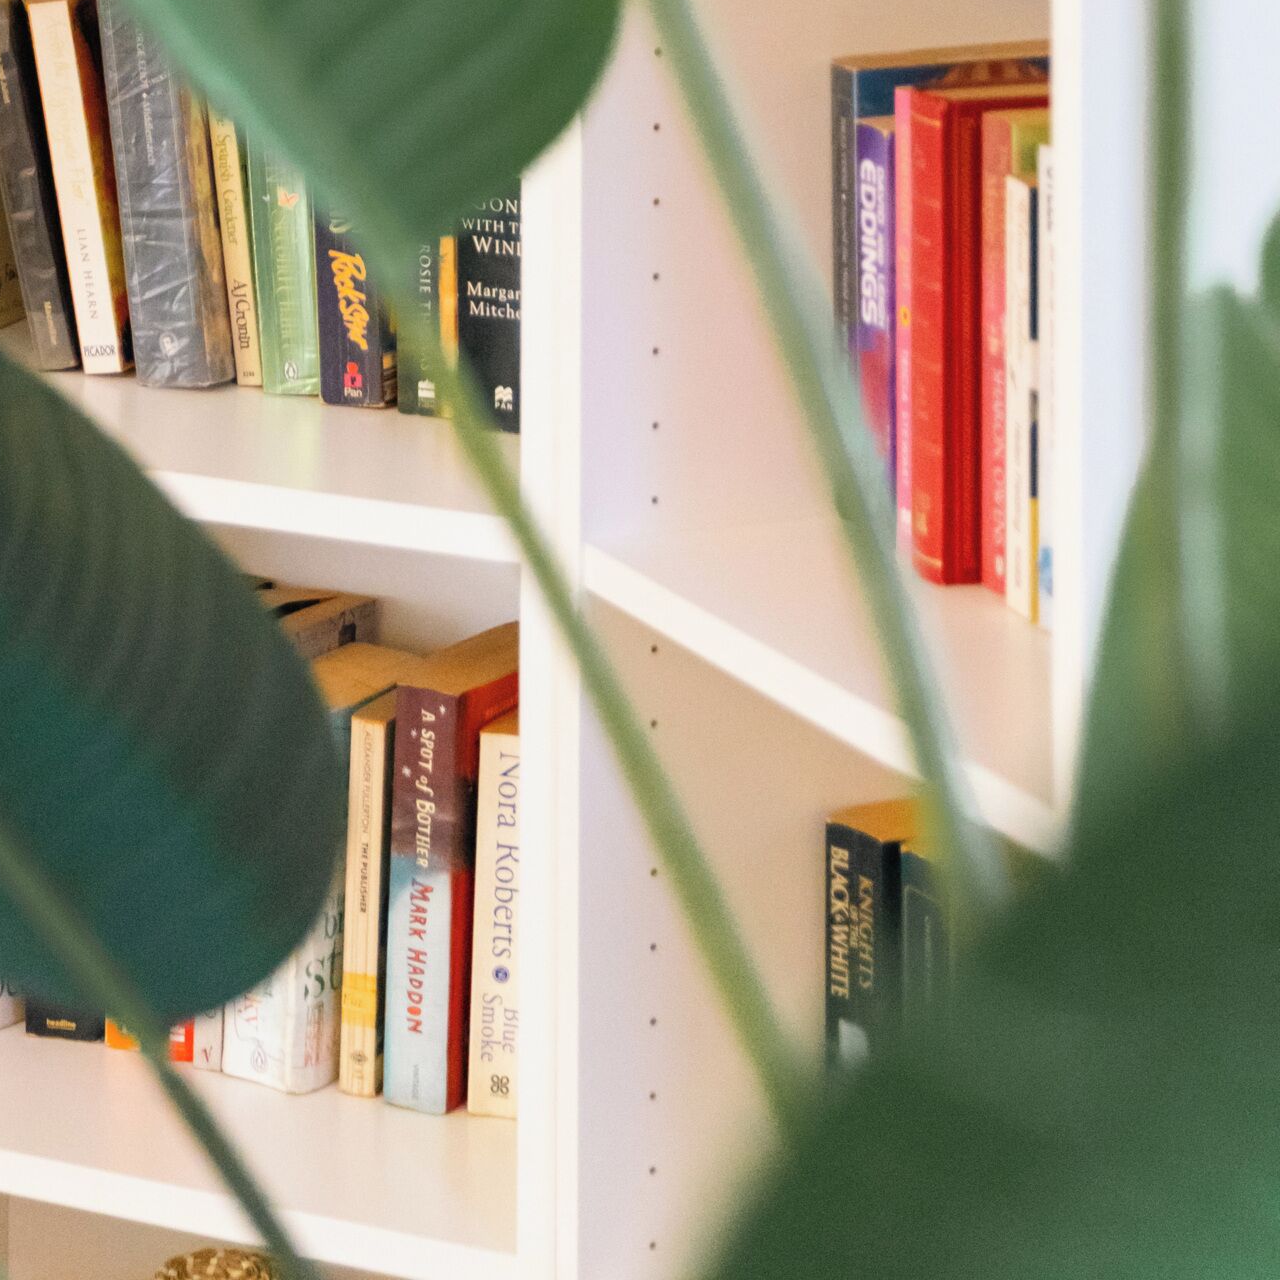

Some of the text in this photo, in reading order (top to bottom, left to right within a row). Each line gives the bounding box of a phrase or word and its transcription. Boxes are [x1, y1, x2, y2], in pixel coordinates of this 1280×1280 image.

[218, 133, 232, 184] Spanish
[223, 189, 238, 244] Gardener
[460, 216, 505, 234] WITH
[859, 158, 879, 326] EDDINGS
[77, 228, 98, 320] LIAN HEARN
[420, 244, 432, 294] ROSIE
[83, 345, 116, 357] PICADOR
[344, 385, 363, 398] Pan
[494, 401, 513, 411] PAN
[415, 708, 436, 869] A SPOT of BOTHER
[359, 730, 373, 914] ALEXANDER FULLERTON THE PUBLISHER
[491, 750, 520, 960] Nora Roberts
[406, 876, 434, 1035] MARK HADDON
[858, 873, 874, 990] KNIGHTS
[46, 1017, 77, 1031] headline
[480, 992, 503, 1062] Smoke
[502, 1007, 519, 1054] Blue
